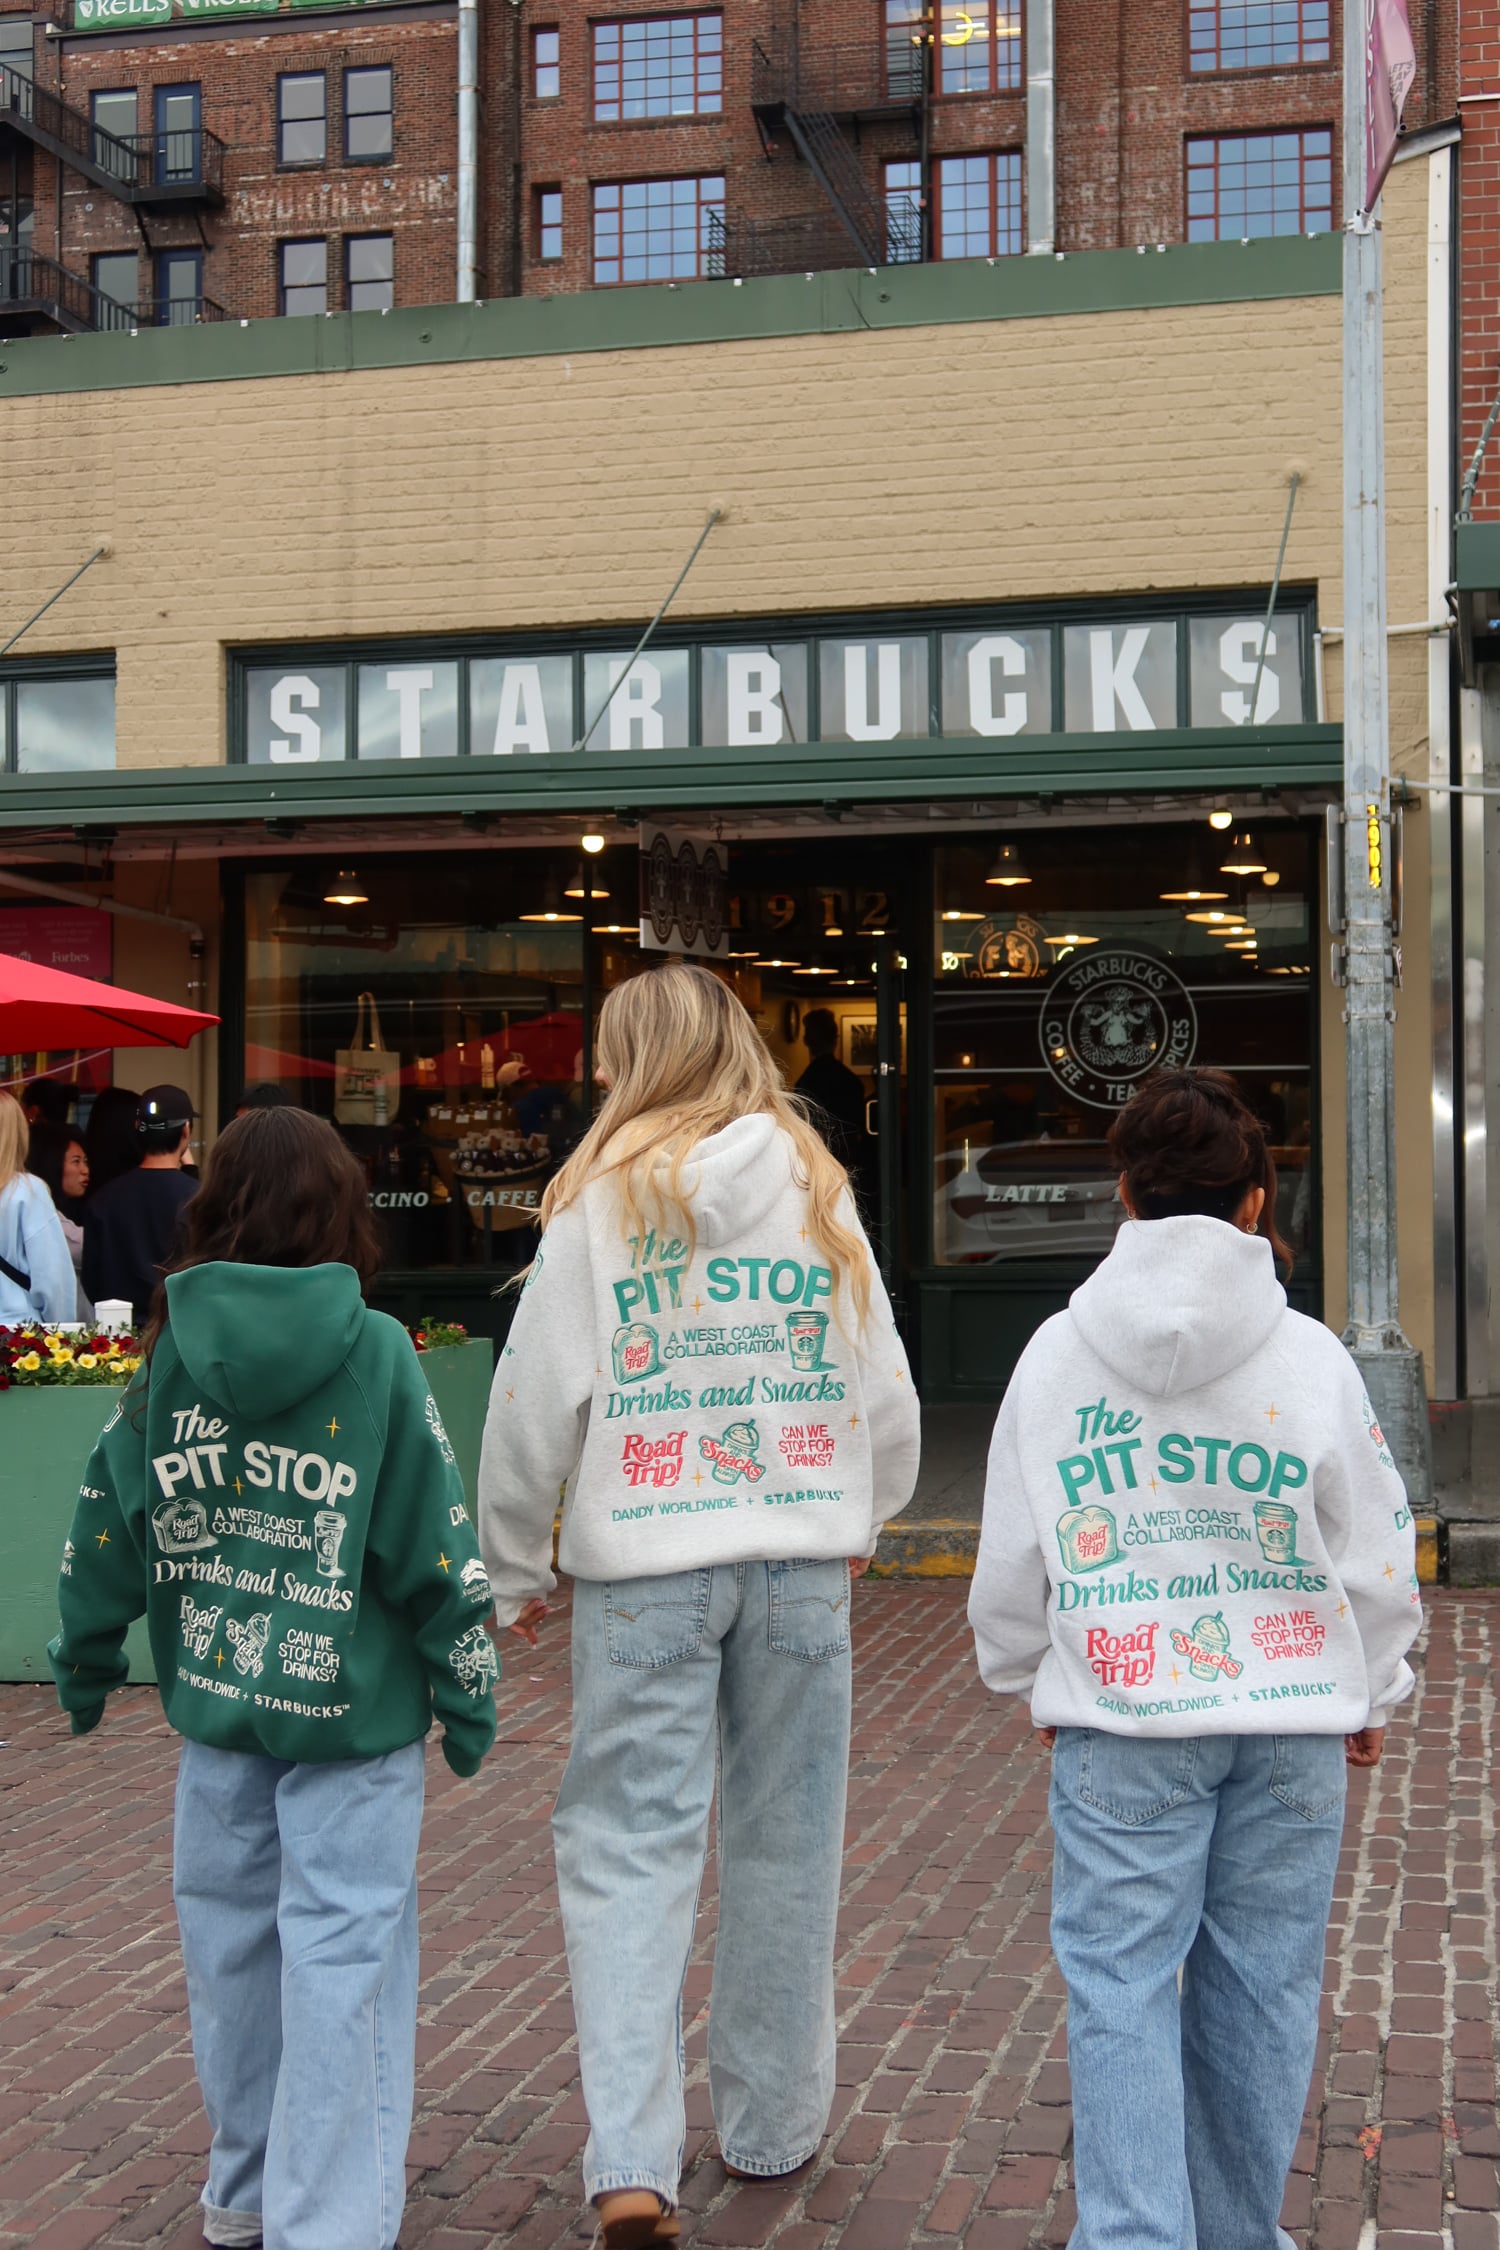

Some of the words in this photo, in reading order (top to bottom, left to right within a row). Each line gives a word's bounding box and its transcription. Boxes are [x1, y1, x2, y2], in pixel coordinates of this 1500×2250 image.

[269, 621, 1280, 763] STARBUCKS
[51, 952, 89, 962] Forbes
[1068, 958, 1167, 991] STARBUCKS
[467, 1190, 538, 1206] CAFFE
[985, 1184, 1068, 1202] LATTE
[628, 1229, 689, 1270] The
[612, 1263, 688, 1324] PIT
[707, 1257, 832, 1308] STOP
[663, 1337, 785, 1360] COLLABORATION
[668, 1331, 679, 1345] A
[683, 1328, 727, 1343] WEST
[731, 1325, 778, 1341] COAST
[624, 1340, 651, 1359] Road
[604, 1380, 692, 1418] Drinks
[700, 1375, 756, 1408] and
[760, 1373, 846, 1404] Snacks
[172, 1404, 229, 1444] The
[781, 1426, 804, 1439] CAN
[807, 1424, 829, 1438] WE
[1075, 1396, 1143, 1444] The
[620, 1430, 688, 1464] Road
[778, 1440, 807, 1453] STOP
[809, 1438, 835, 1452] FOR
[623, 1456, 684, 1488] Trip!
[701, 1438, 763, 1481] Snacks
[787, 1453, 833, 1468] DRINKS?
[1056, 1438, 1143, 1507] PIT
[1158, 1433, 1308, 1499] STOP
[152, 1443, 228, 1498] PIT
[244, 1441, 357, 1508] STOP
[173, 1513, 199, 1531] Road
[214, 1507, 225, 1521] A
[228, 1507, 263, 1526] WEST
[264, 1513, 305, 1534] COAST
[611, 1506, 654, 1522] DANDY
[658, 1496, 738, 1515] WORLDWIDE
[1127, 1513, 1139, 1529] A
[1143, 1510, 1181, 1527] WEST
[1185, 1509, 1241, 1526] COAST
[212, 1521, 311, 1550] COLLABORATION
[1077, 1525, 1109, 1547] Road
[1079, 1540, 1106, 1558] Trip!
[1123, 1525, 1251, 1546] COLLABORATION
[153, 1554, 234, 1586] Drinks
[235, 1567, 277, 1596] and
[280, 1572, 354, 1612] Snacks
[1057, 1570, 1159, 1611] Drinks
[1167, 1564, 1219, 1598] and
[1226, 1562, 1328, 1592] Snacks
[179, 1594, 223, 1629] Road
[1254, 1615, 1287, 1630] CAN
[1289, 1611, 1317, 1627] WE
[181, 1622, 214, 1660] Trip!
[226, 1618, 264, 1678] Snacks
[287, 1628, 313, 1648] CAN
[315, 1634, 334, 1651] WE
[1086, 1622, 1159, 1659] Road
[1251, 1630, 1291, 1646] STOP
[1293, 1625, 1326, 1642] FOR
[278, 1642, 311, 1660] STOP
[313, 1651, 340, 1669] FOR
[1172, 1632, 1241, 1677] Snacks
[1263, 1641, 1324, 1661] DRINKS?
[282, 1660, 338, 1683] DRINKS?
[1091, 1651, 1155, 1688] Trip!
[190, 1672, 241, 1699] WORLDWIDE
[1134, 1695, 1224, 1718] WORLDWIDE
